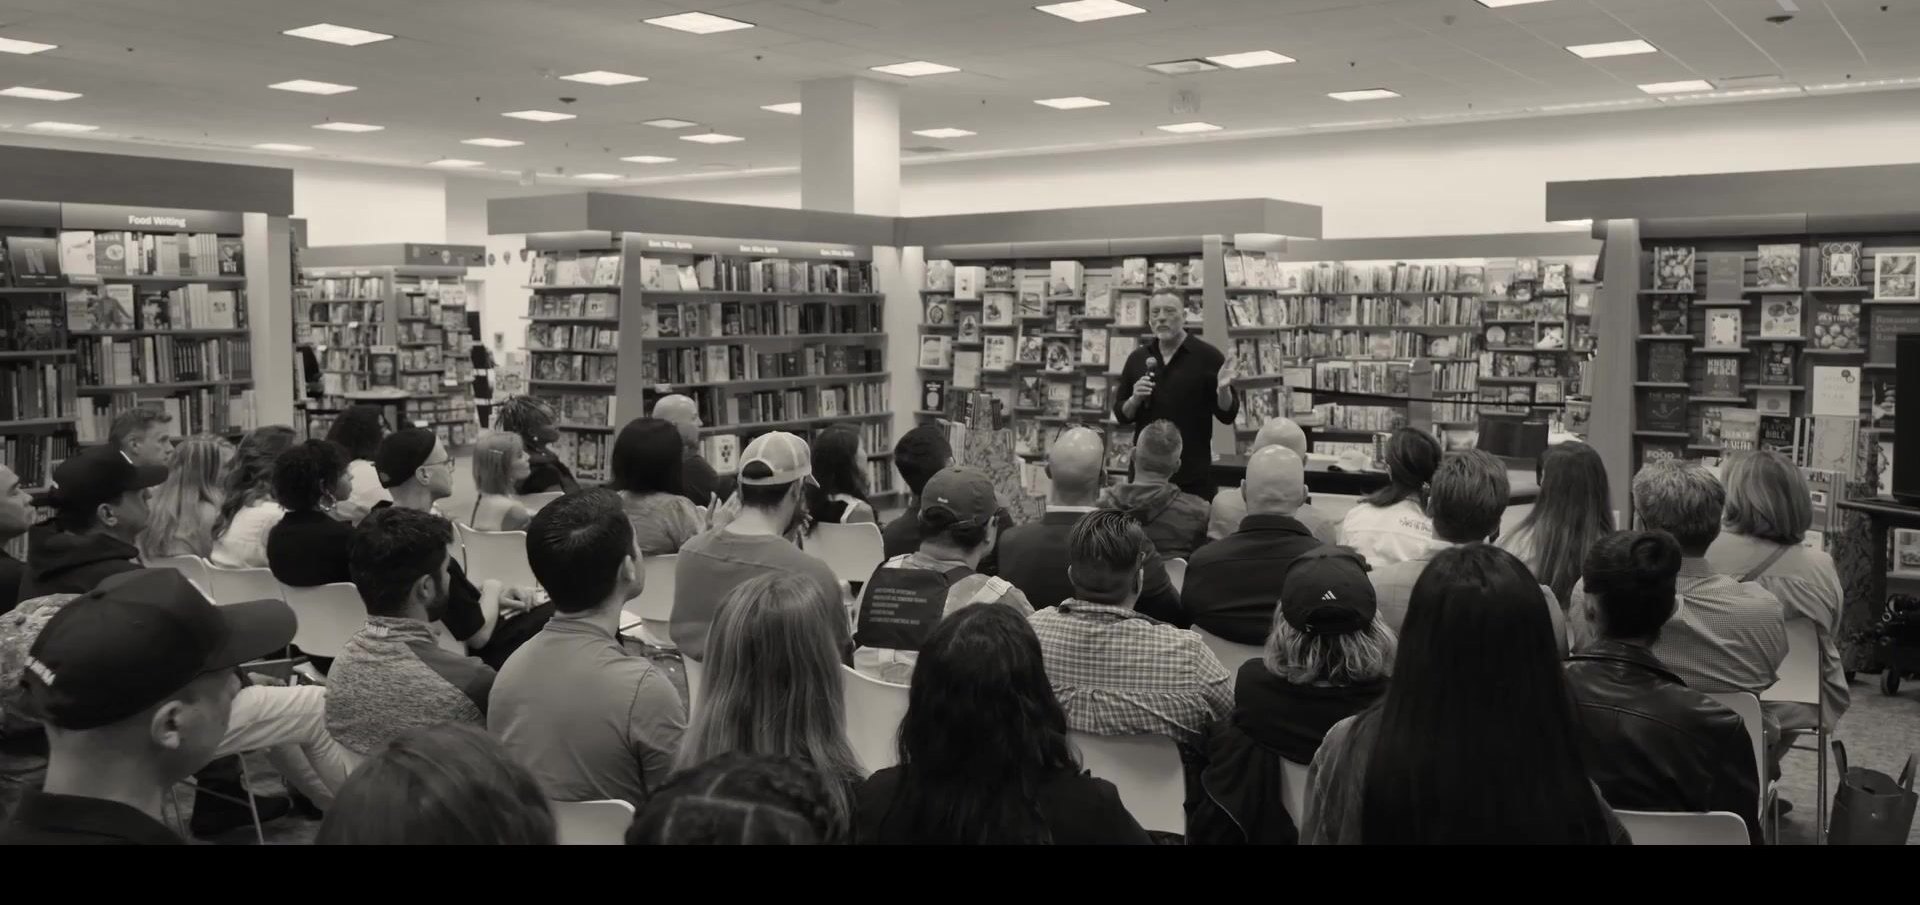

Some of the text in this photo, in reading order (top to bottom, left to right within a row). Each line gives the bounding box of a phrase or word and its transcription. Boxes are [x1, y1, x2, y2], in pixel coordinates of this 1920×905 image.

[128, 215, 186, 228] Food Writing
[1707, 358, 1737, 367] KNEAD
[1707, 367, 1737, 377] PEACE
